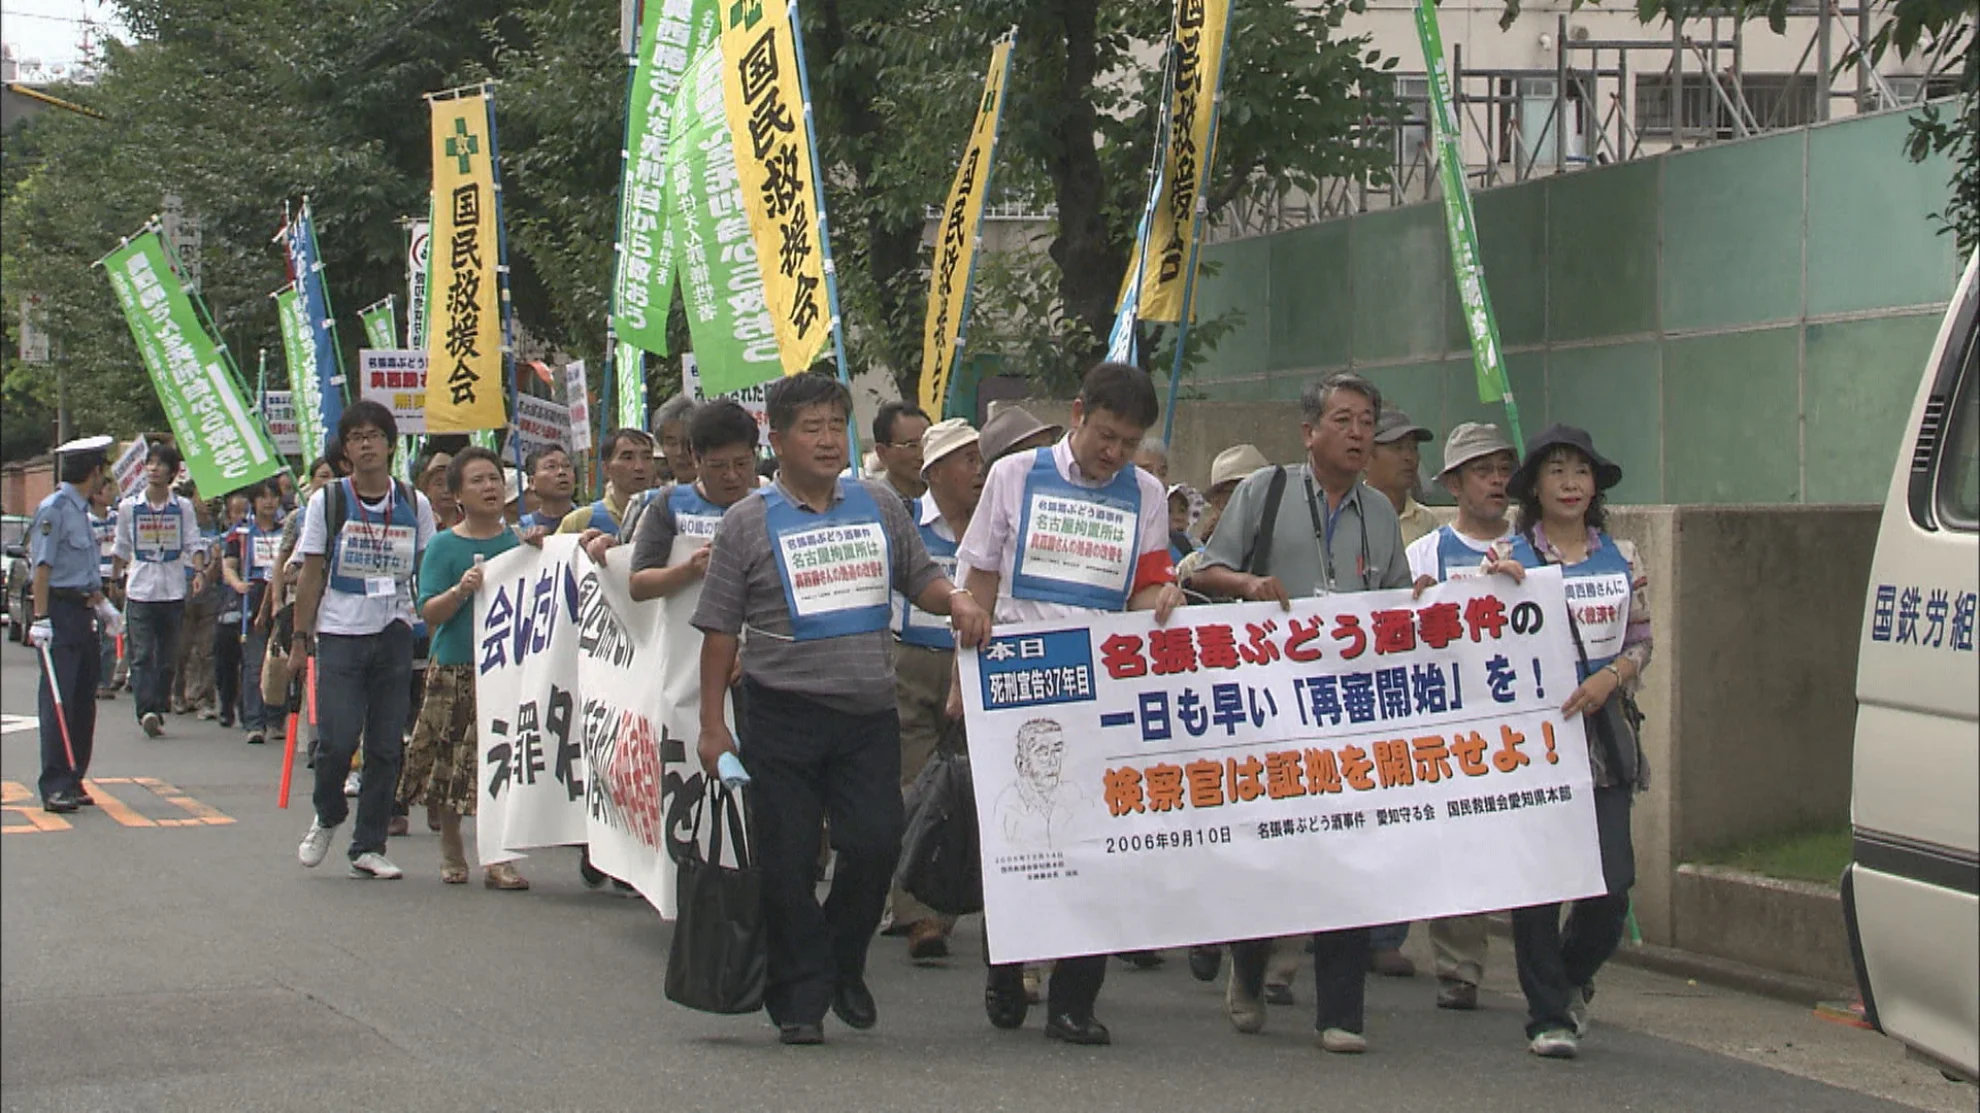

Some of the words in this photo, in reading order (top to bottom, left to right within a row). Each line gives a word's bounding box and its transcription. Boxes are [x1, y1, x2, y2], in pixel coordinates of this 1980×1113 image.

[738, 28, 819, 339] 国民救援会
[446, 183, 482, 405] 国民救援会
[791, 541, 880, 569] 名古屋拘置所は
[1036, 513, 1125, 542] 名古屋拘置所は
[986, 638, 1045, 661] 本日
[1100, 594, 1544, 682] 名張毒ぶどう酒事件の
[1872, 584, 1977, 651] 国鉄労組
[989, 664, 1090, 704] 死刑宣告37年目
[1102, 720, 1560, 816] 検察官は証拠を開示せよ！
[1106, 826, 1231, 853] 2006年9月10日
[1257, 811, 1366, 840] 名張毒ぶどう酒事件
[1376, 804, 1436, 827] 愛知守る会
[1447, 785, 1573, 817] 国民救援会愛知県本部
